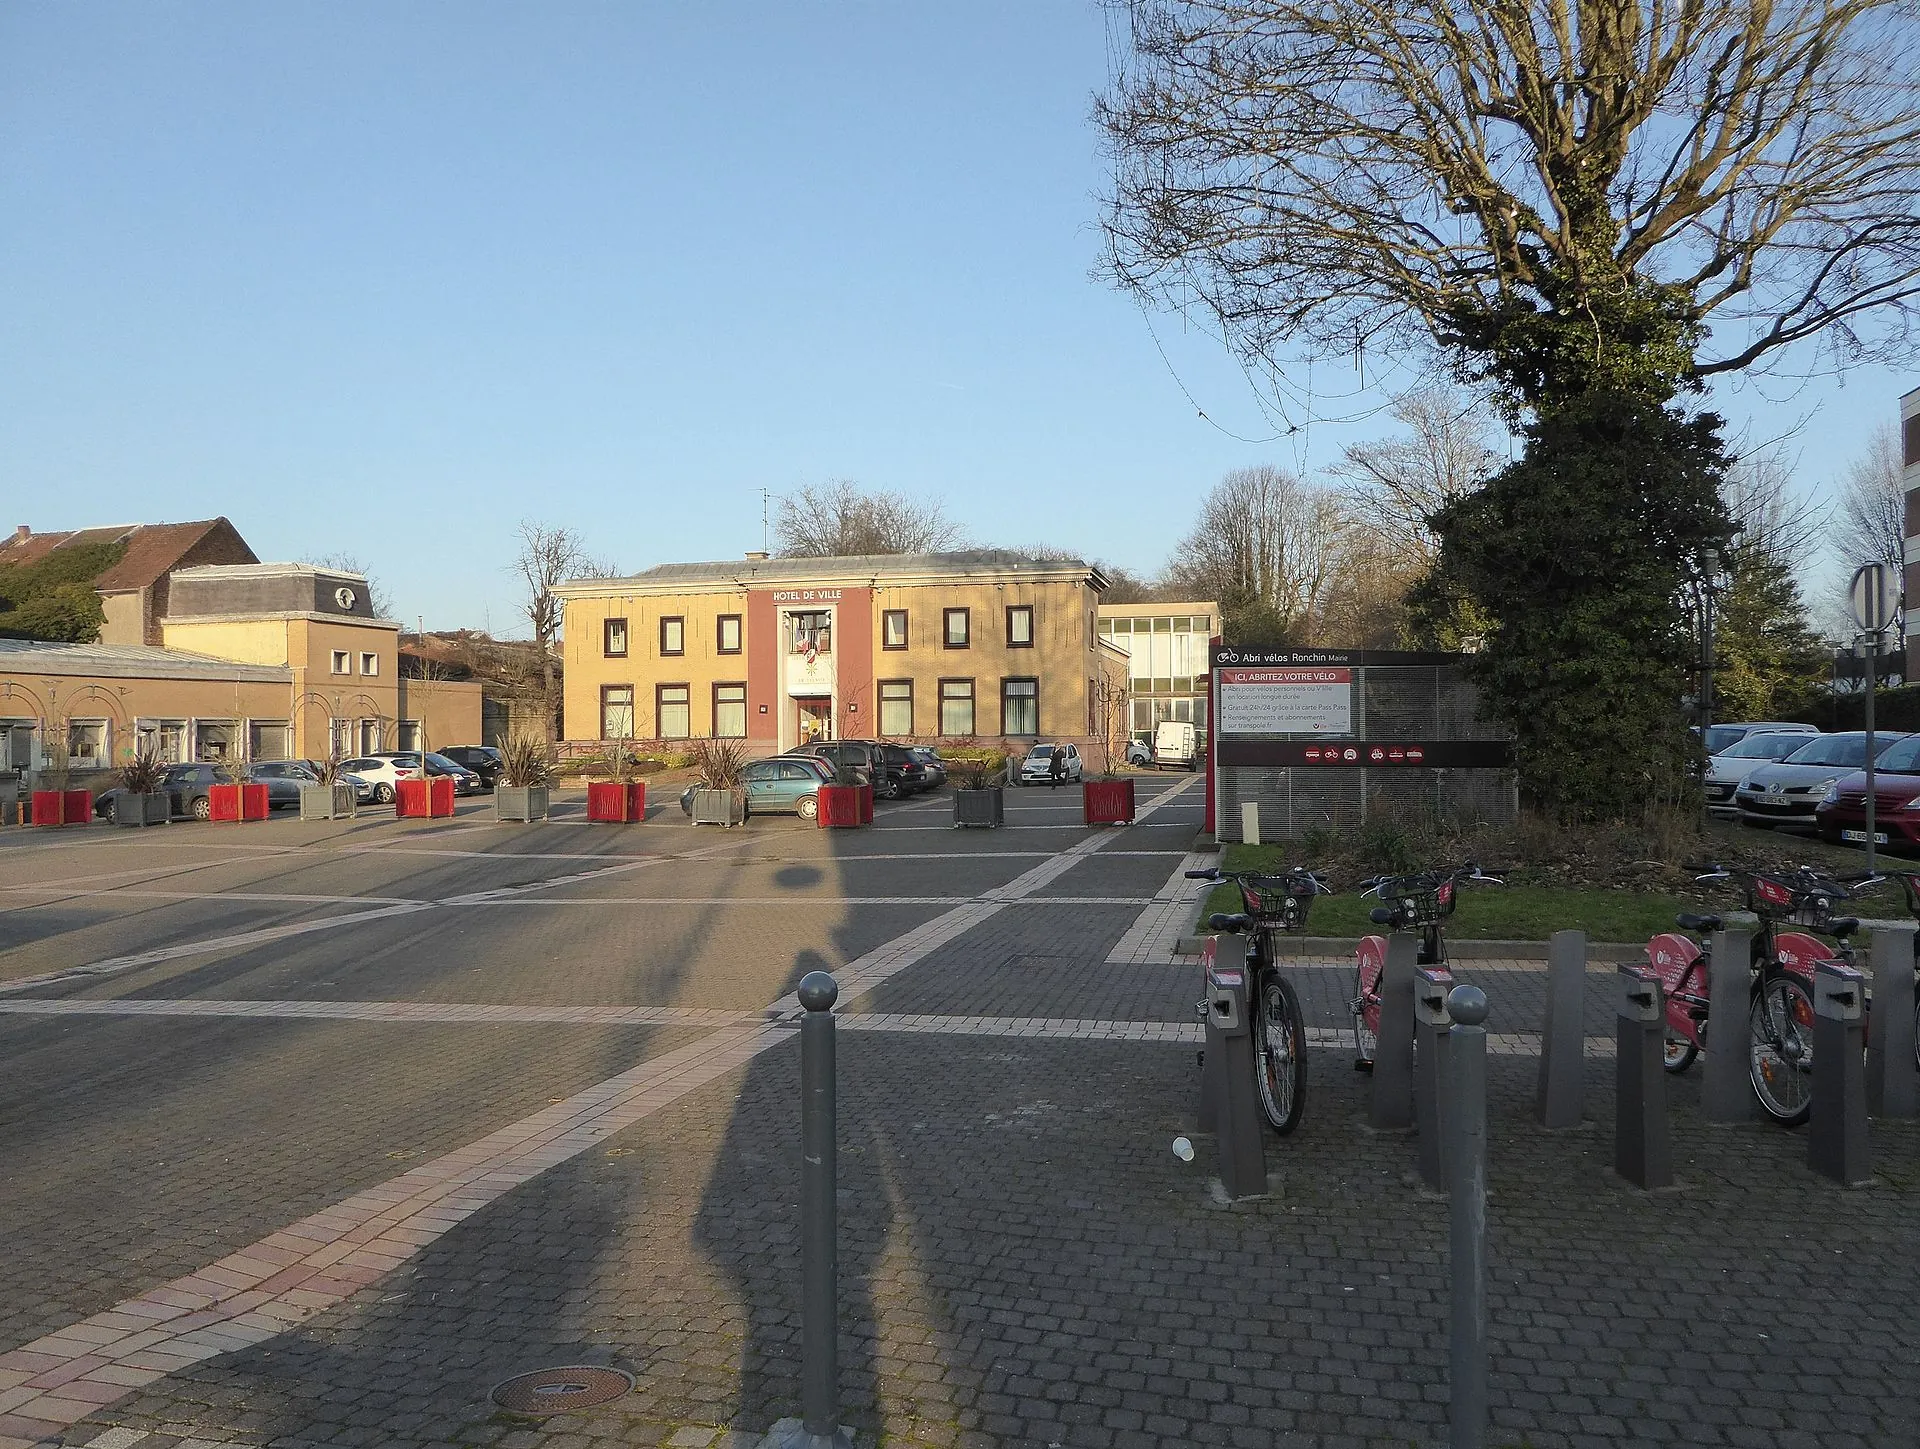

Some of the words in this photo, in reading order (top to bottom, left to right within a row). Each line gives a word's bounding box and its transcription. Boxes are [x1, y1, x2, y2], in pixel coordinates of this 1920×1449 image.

[774, 592, 800, 600] HOTEL
[803, 590, 814, 600] DE
[817, 590, 841, 599] VILLE
[1243, 654, 1260, 662] Abri
[1264, 654, 1288, 662] vélos
[1292, 653, 1326, 661] Ronchin
[1235, 674, 1247, 682] ICI,
[1248, 673, 1283, 681] ABRITEZ
[1273, 685, 1306, 693] personnels
[1260, 693, 1281, 701] longue
[1271, 703, 1289, 712] grâce
[1318, 703, 1332, 711] Pass
[1332, 703, 1347, 711] Pass
[1227, 713, 1276, 722] Renseignements
